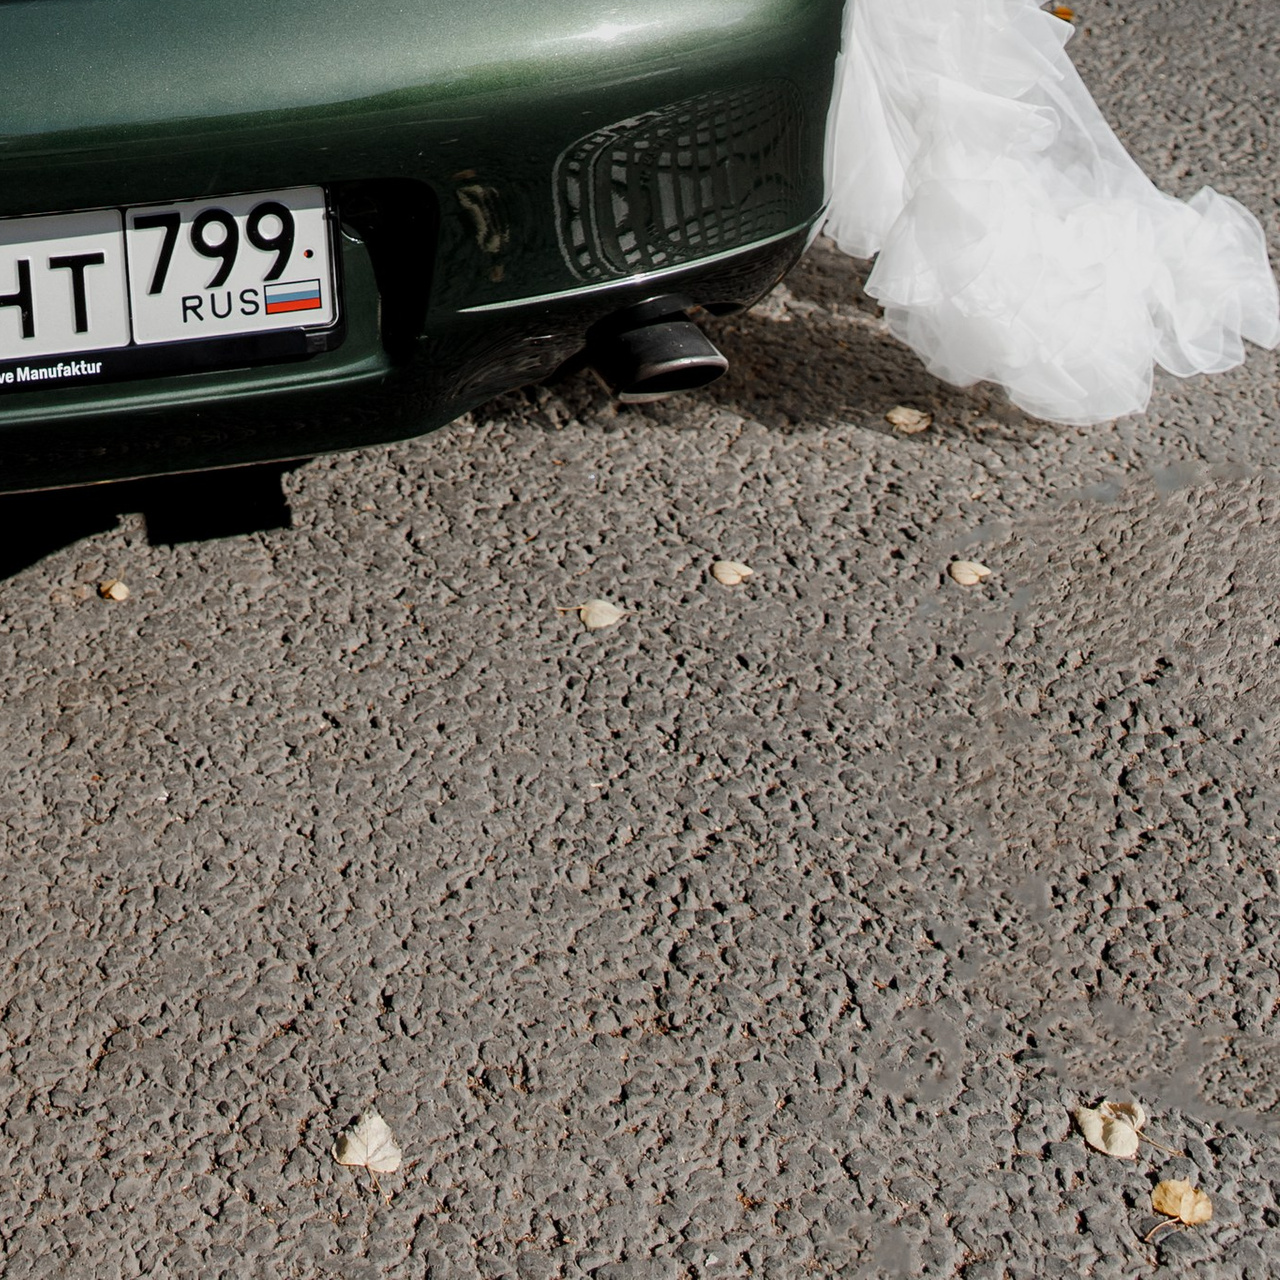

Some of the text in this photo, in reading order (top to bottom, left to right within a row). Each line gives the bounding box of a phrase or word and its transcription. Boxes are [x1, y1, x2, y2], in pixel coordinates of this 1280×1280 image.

[133, 201, 295, 295] 799
[181, 288, 260, 323] RUS
[16, 360, 103, 382] Manufaktur
